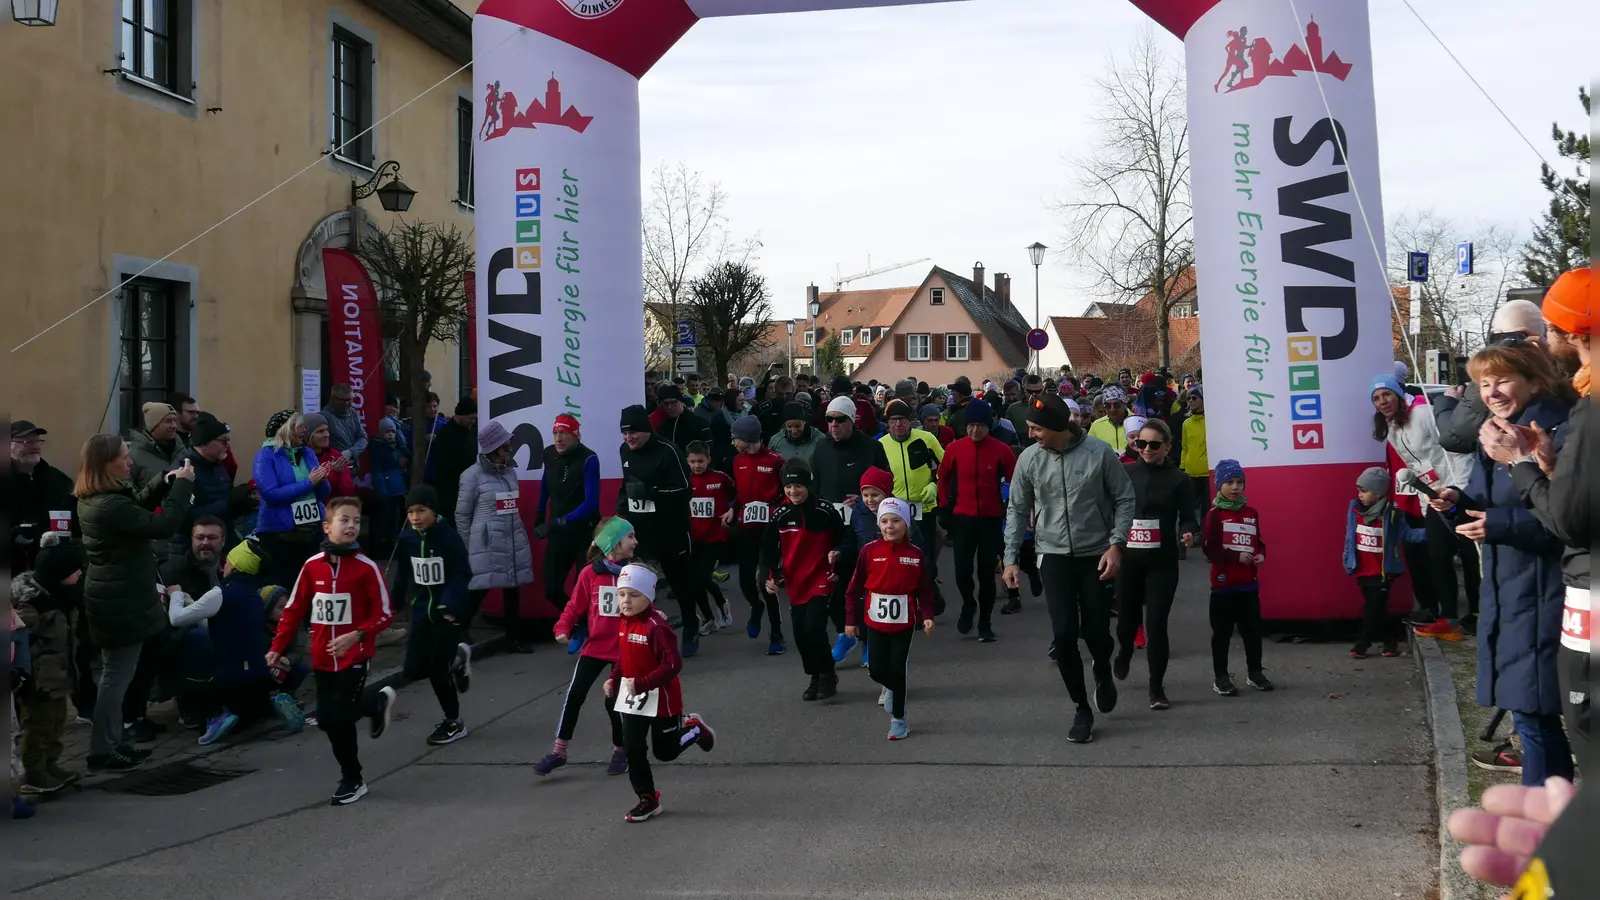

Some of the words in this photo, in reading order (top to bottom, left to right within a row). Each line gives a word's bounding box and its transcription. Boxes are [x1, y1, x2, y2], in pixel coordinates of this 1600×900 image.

[1232, 123, 1261, 200] mehr
[554, 168, 579, 223] hier
[517, 170, 540, 267] PLUS
[556, 231, 580, 274] für
[1273, 115, 1359, 361] SWD
[1236, 211, 1266, 322] Energie
[557, 284, 587, 387] Energie
[1244, 334, 1271, 381] für
[1289, 339, 1321, 446] PLUS
[1248, 391, 1275, 451] hier
[295, 502, 318, 521] 403
[503, 500, 516, 509] 325
[692, 502, 713, 516] 346
[745, 505, 767, 521] 390
[1130, 530, 1151, 542] 363
[1232, 533, 1251, 545] 305
[1360, 535, 1377, 546] 303
[416, 562, 441, 583] 400
[316, 599, 347, 622] 387
[877, 598, 900, 620] 50
